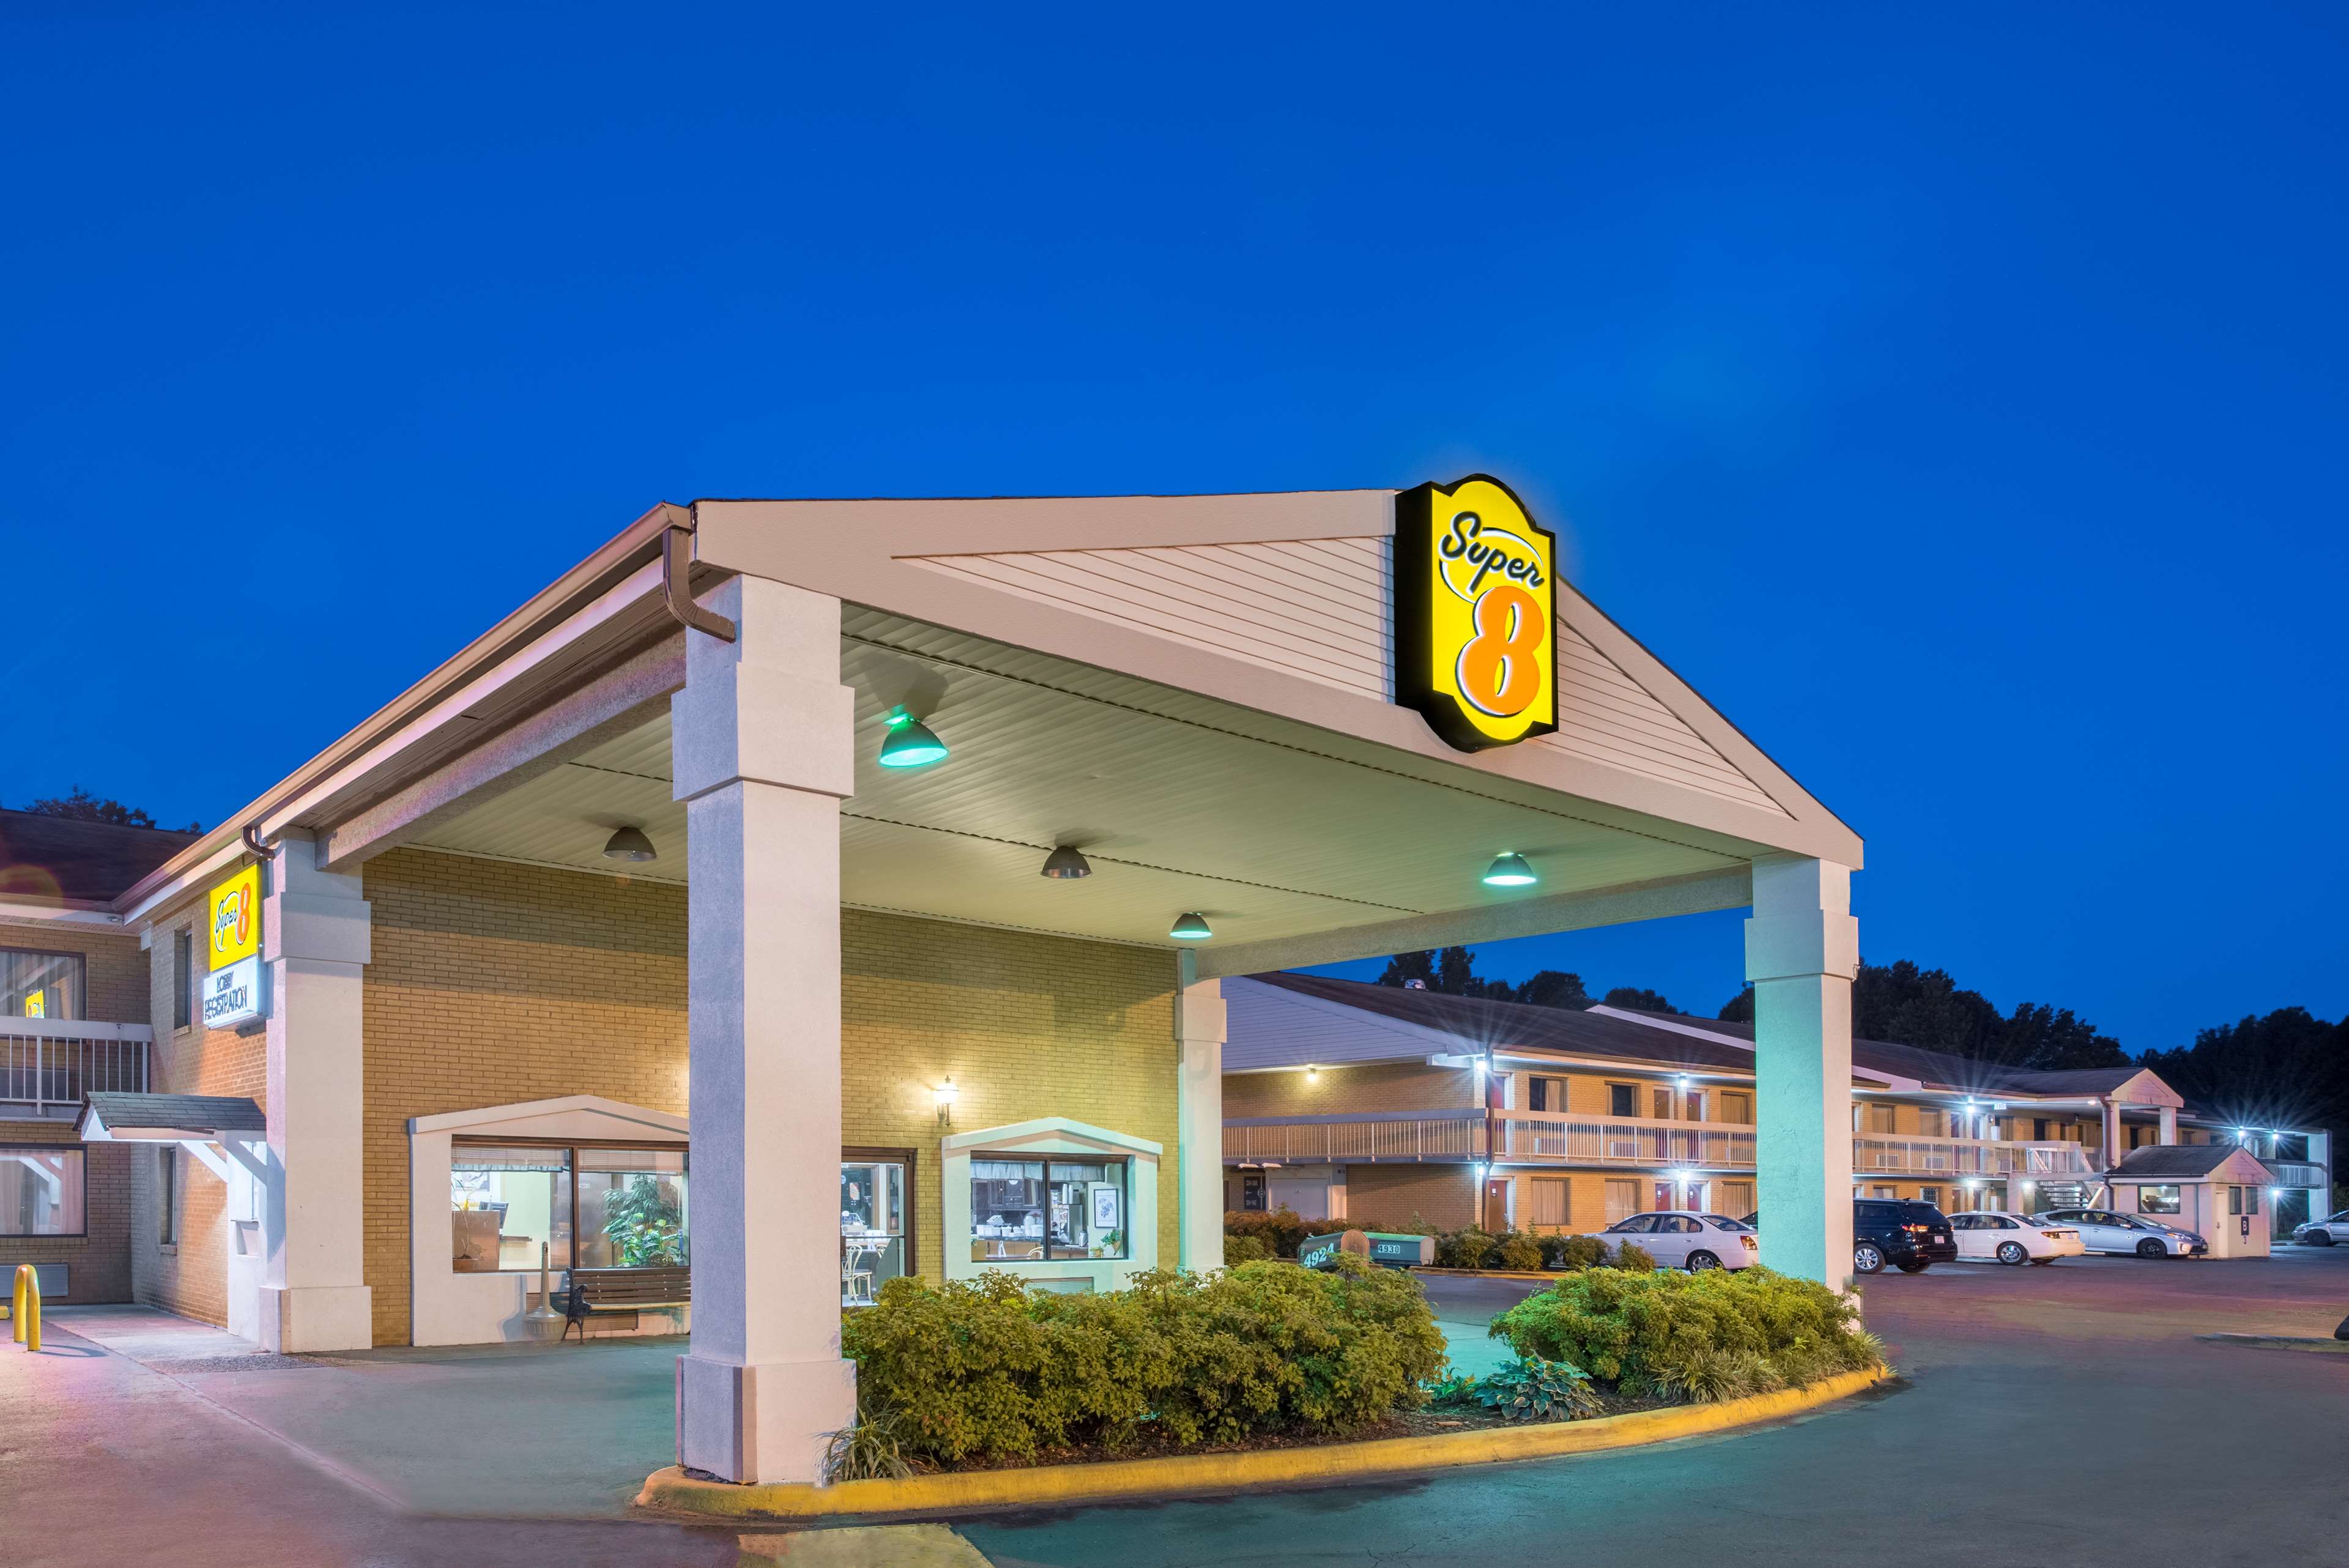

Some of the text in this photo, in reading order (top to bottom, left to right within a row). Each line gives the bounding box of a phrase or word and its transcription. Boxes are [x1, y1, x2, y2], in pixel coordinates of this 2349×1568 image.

[1440, 511, 1545, 595] Super
[1455, 585, 1545, 718] 8
[215, 882, 251, 947] Super 8
[205, 984, 247, 1020] REGISTRATION
[1304, 1243, 1334, 1268] 4924
[1378, 1244, 1399, 1253] 4930
